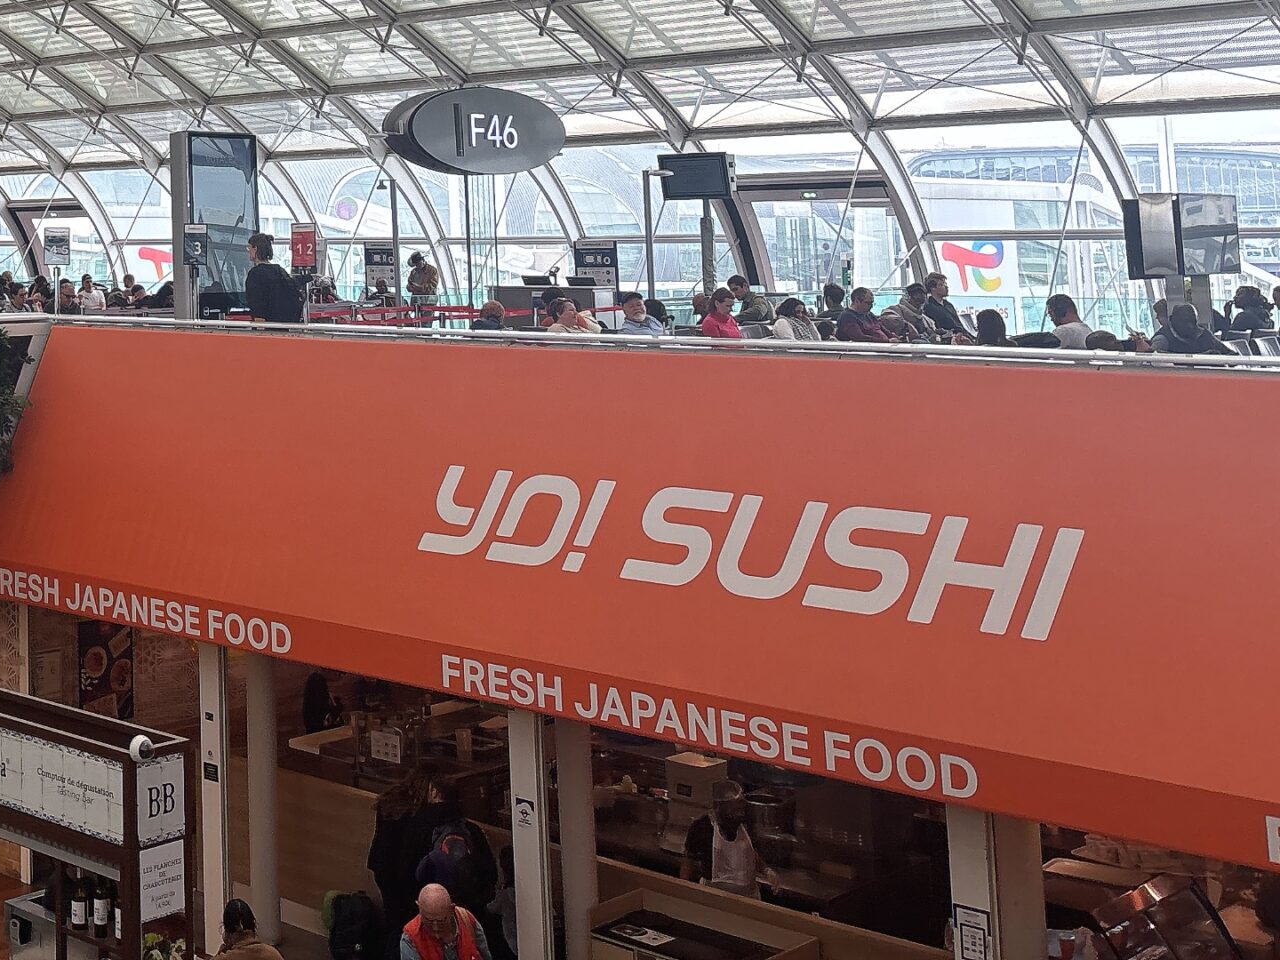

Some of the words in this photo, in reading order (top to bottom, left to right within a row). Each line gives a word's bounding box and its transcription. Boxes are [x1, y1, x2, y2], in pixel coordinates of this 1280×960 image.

[470, 113, 518, 149] F46
[194, 242, 202, 254] 3
[296, 243, 302, 255] 1
[306, 243, 313, 255] 2
[418, 465, 616, 572] YO!
[620, 486, 1085, 641] SUSHI
[65, 583, 200, 636] JAPANESE
[207, 609, 292, 654] FOOD
[441, 654, 563, 712] FRESH
[575, 683, 811, 766] JAPANESE
[823, 730, 978, 798] FOOD
[37, 767, 66, 783] Comptoir
[67, 777, 75, 787] de
[76, 781, 114, 799] dégustation
